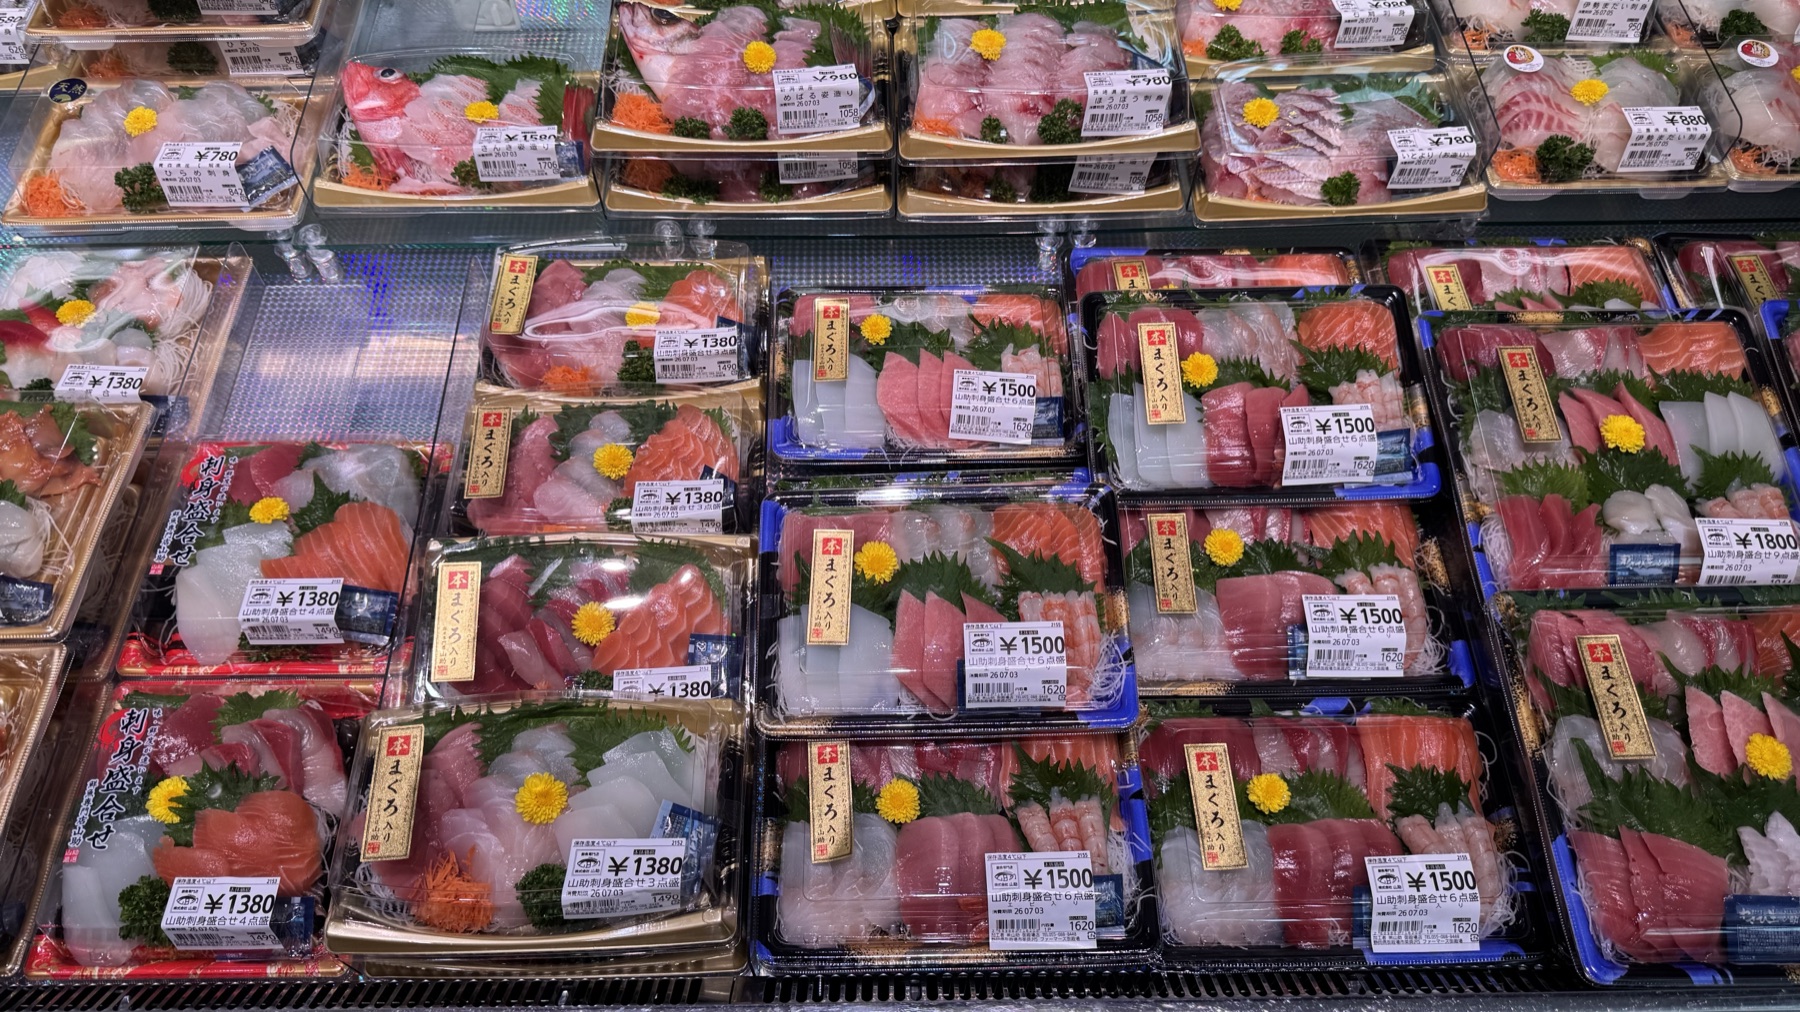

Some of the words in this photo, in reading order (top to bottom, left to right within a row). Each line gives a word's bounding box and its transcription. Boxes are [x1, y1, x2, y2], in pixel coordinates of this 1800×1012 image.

[1390, 27, 1408, 37] 1058
[1627, 22, 1642, 32] 950
[8, 45, 24, 54] 626
[285, 55, 300, 65] 842
[812, 73, 858, 83] ¥980
[1124, 75, 1172, 87] ¥980
[839, 110, 859, 120] 1058
[1144, 112, 1164, 123] 1058
[1662, 114, 1708, 126] ¥880
[1427, 134, 1474, 147] ¥780
[194, 150, 239, 162] ¥780
[1684, 149, 1701, 159] 950
[538, 161, 559, 171] 1706
[838, 160, 857, 169] 1058
[1450, 167, 1466, 177] 842
[1129, 176, 1148, 184] 1058
[227, 187, 245, 197] 842
[683, 336, 738, 350] ¥1380
[717, 362, 737, 374] 1490
[87, 375, 143, 390] ¥1380
[982, 381, 1036, 400] ¥1500
[1012, 420, 1032, 434] 1620
[1314, 417, 1375, 435] ¥1500
[1352, 460, 1375, 471] 1620
[664, 490, 724, 506] ¥1380
[170, 455, 226, 567] 刺身盛合せ
[1732, 531, 1798, 550] ¥1800
[275, 590, 340, 607] ¥1380
[1339, 607, 1403, 625] ¥1500
[314, 625, 339, 635] 1490
[1311, 625, 1405, 635] 山助刺身盛合せ6点盛
[998, 634, 1066, 656] ¥1500
[968, 655, 1066, 667] 山助刺身盛合せ6点盛
[1380, 650, 1403, 663] 1620
[648, 680, 712, 699] ¥1380
[1041, 684, 1066, 696] 1620
[86, 707, 149, 852] 刺身盛合せ
[607, 856, 683, 876] ¥1380
[567, 877, 680, 890] 山助刺身盛合せ3点盛
[1023, 868, 1094, 891] ¥1500
[1405, 869, 1477, 893] ¥1500
[202, 892, 276, 915] ¥1380
[991, 891, 1095, 905] 山助刺身盛合せ6点盛
[1376, 892, 1479, 906] 山助刺身盛合せ6点盛
[164, 914, 270, 927] 山助刺身盛合せ4点盛
[1068, 920, 1095, 932] 1620
[1452, 921, 1478, 934] 1620
[249, 933, 275, 944] 1490
